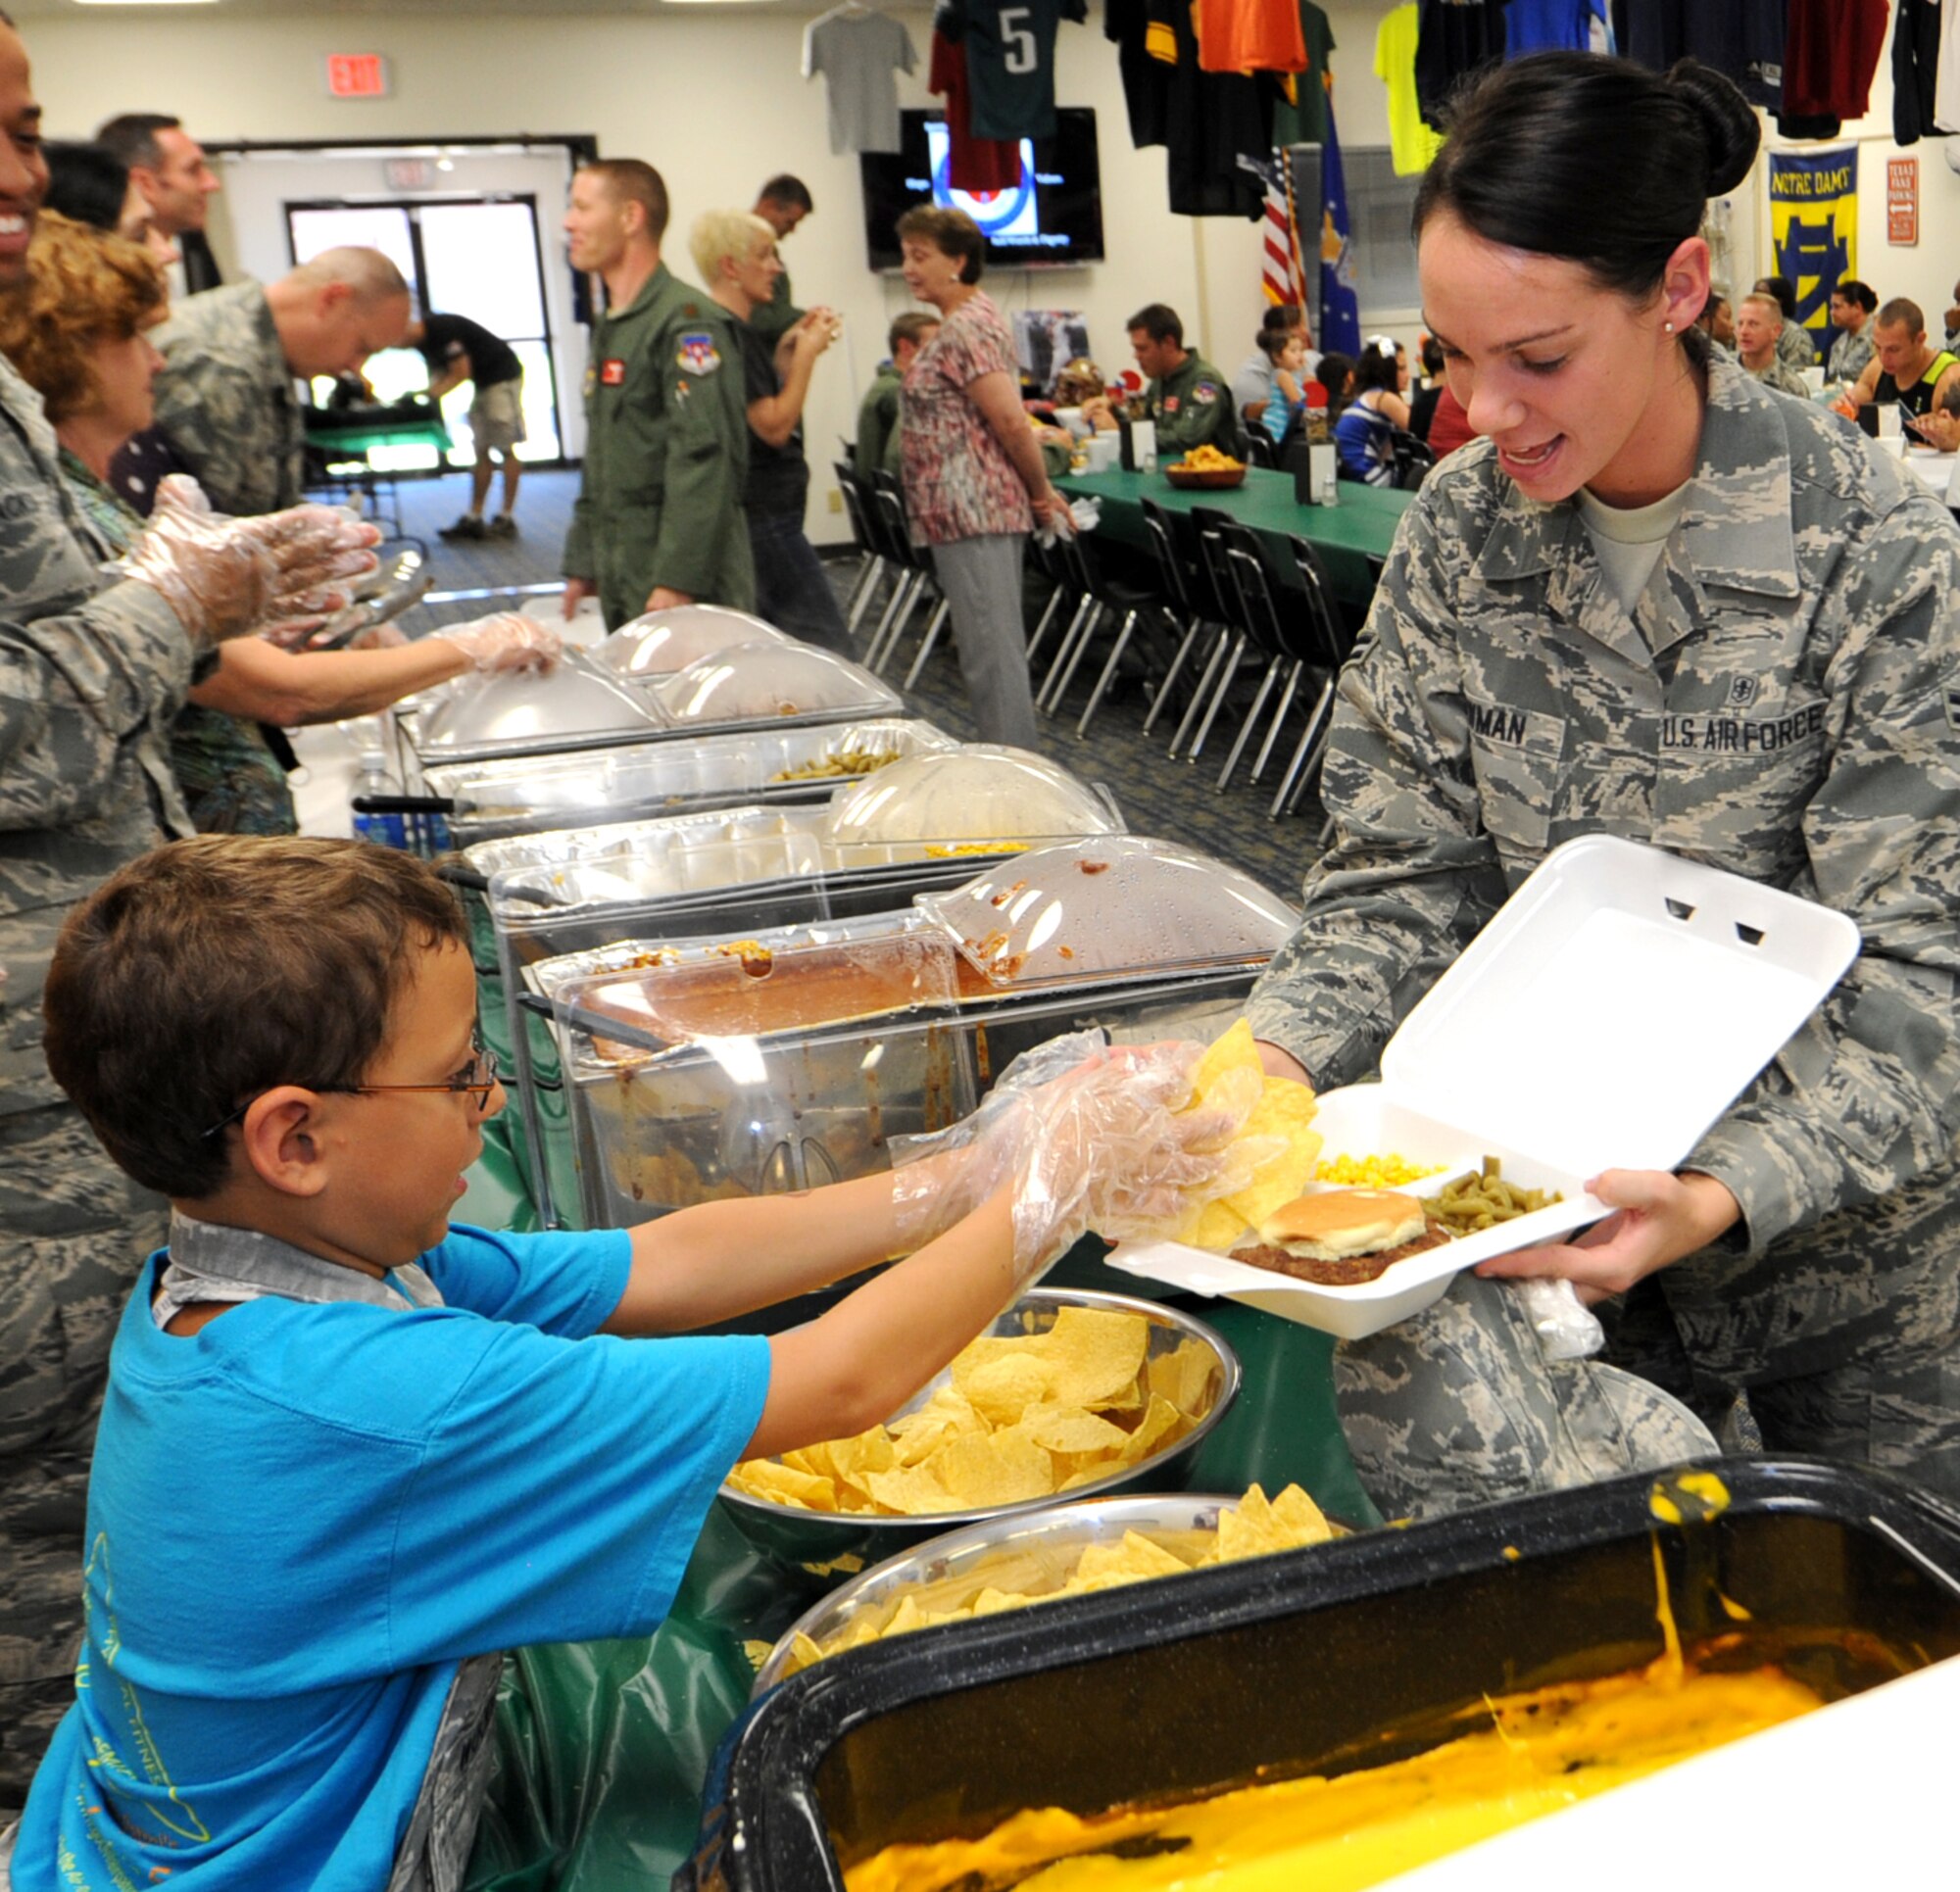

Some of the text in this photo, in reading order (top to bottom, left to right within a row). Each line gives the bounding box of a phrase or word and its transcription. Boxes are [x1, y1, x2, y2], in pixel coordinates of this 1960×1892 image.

[999, 7, 1037, 73] 5
[328, 55, 382, 96] EXIT
[1888, 163, 1914, 176] TEXAS
[1468, 703, 1527, 745] MAN
[1663, 703, 1824, 752] U.S. AIR FORCE
